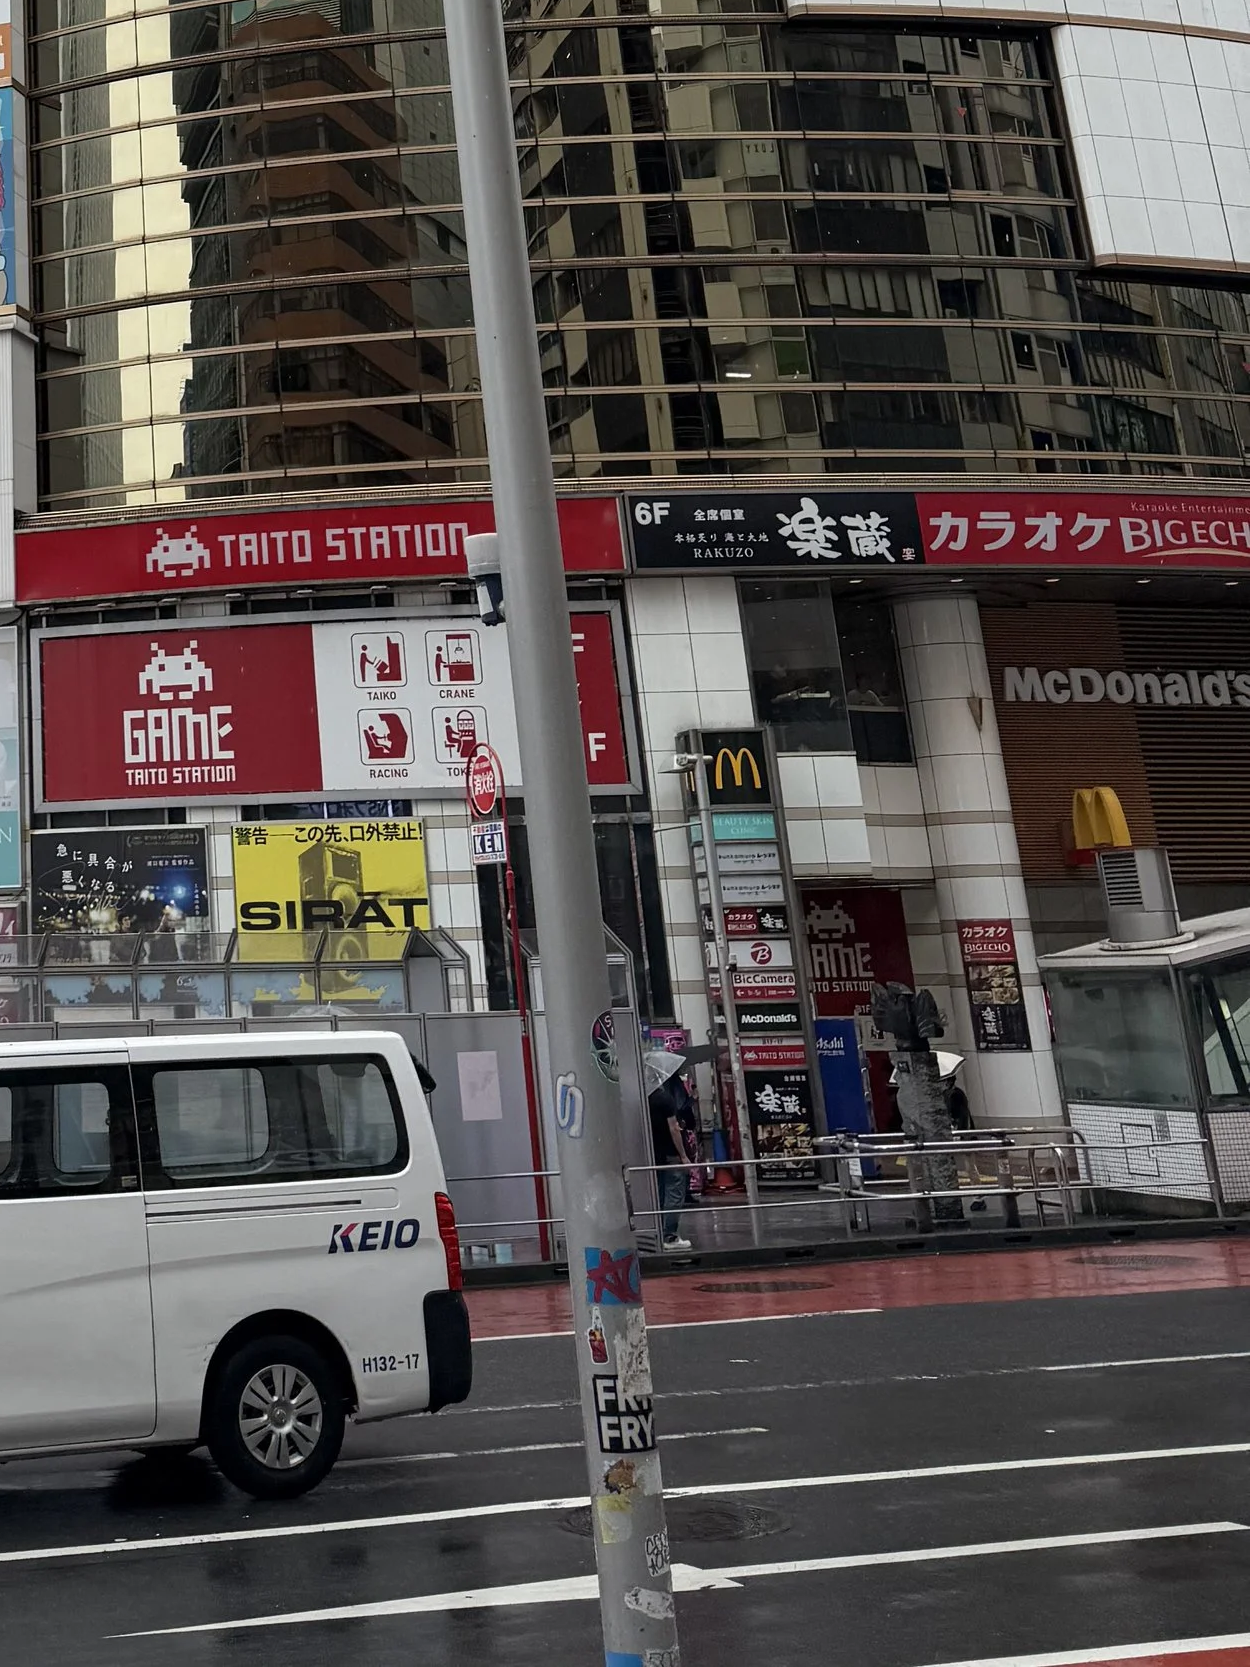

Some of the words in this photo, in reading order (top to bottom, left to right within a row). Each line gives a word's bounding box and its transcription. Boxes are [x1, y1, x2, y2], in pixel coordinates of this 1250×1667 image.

[634, 502, 670, 525] 6F
[693, 509, 745, 521] 全席個室
[1130, 501, 1178, 512] Karaoke
[776, 496, 896, 563] 楽蔵
[929, 510, 1111, 552] カラオケ
[217, 528, 313, 569] TAITO
[326, 521, 469, 563] STATION
[693, 547, 754, 559] RAKUZO
[366, 690, 398, 702] TAIKO
[438, 688, 476, 700] CRANE
[123, 705, 235, 765] GAME
[587, 732, 607, 762] F
[125, 767, 168, 786] TAITO
[172, 765, 237, 785] STATION
[369, 768, 409, 780] RACING
[475, 834, 502, 854] KEN
[56, 843, 133, 872] 急に具合が
[61, 870, 115, 892] 悪くなる
[962, 926, 1008, 938] カラオケ
[734, 972, 795, 984] BicCamera
[741, 1014, 797, 1024] McDonald's
[816, 1036, 844, 1050] Asahi
[328, 1217, 420, 1254] KEIO
[362, 1352, 420, 1374] H132-17
